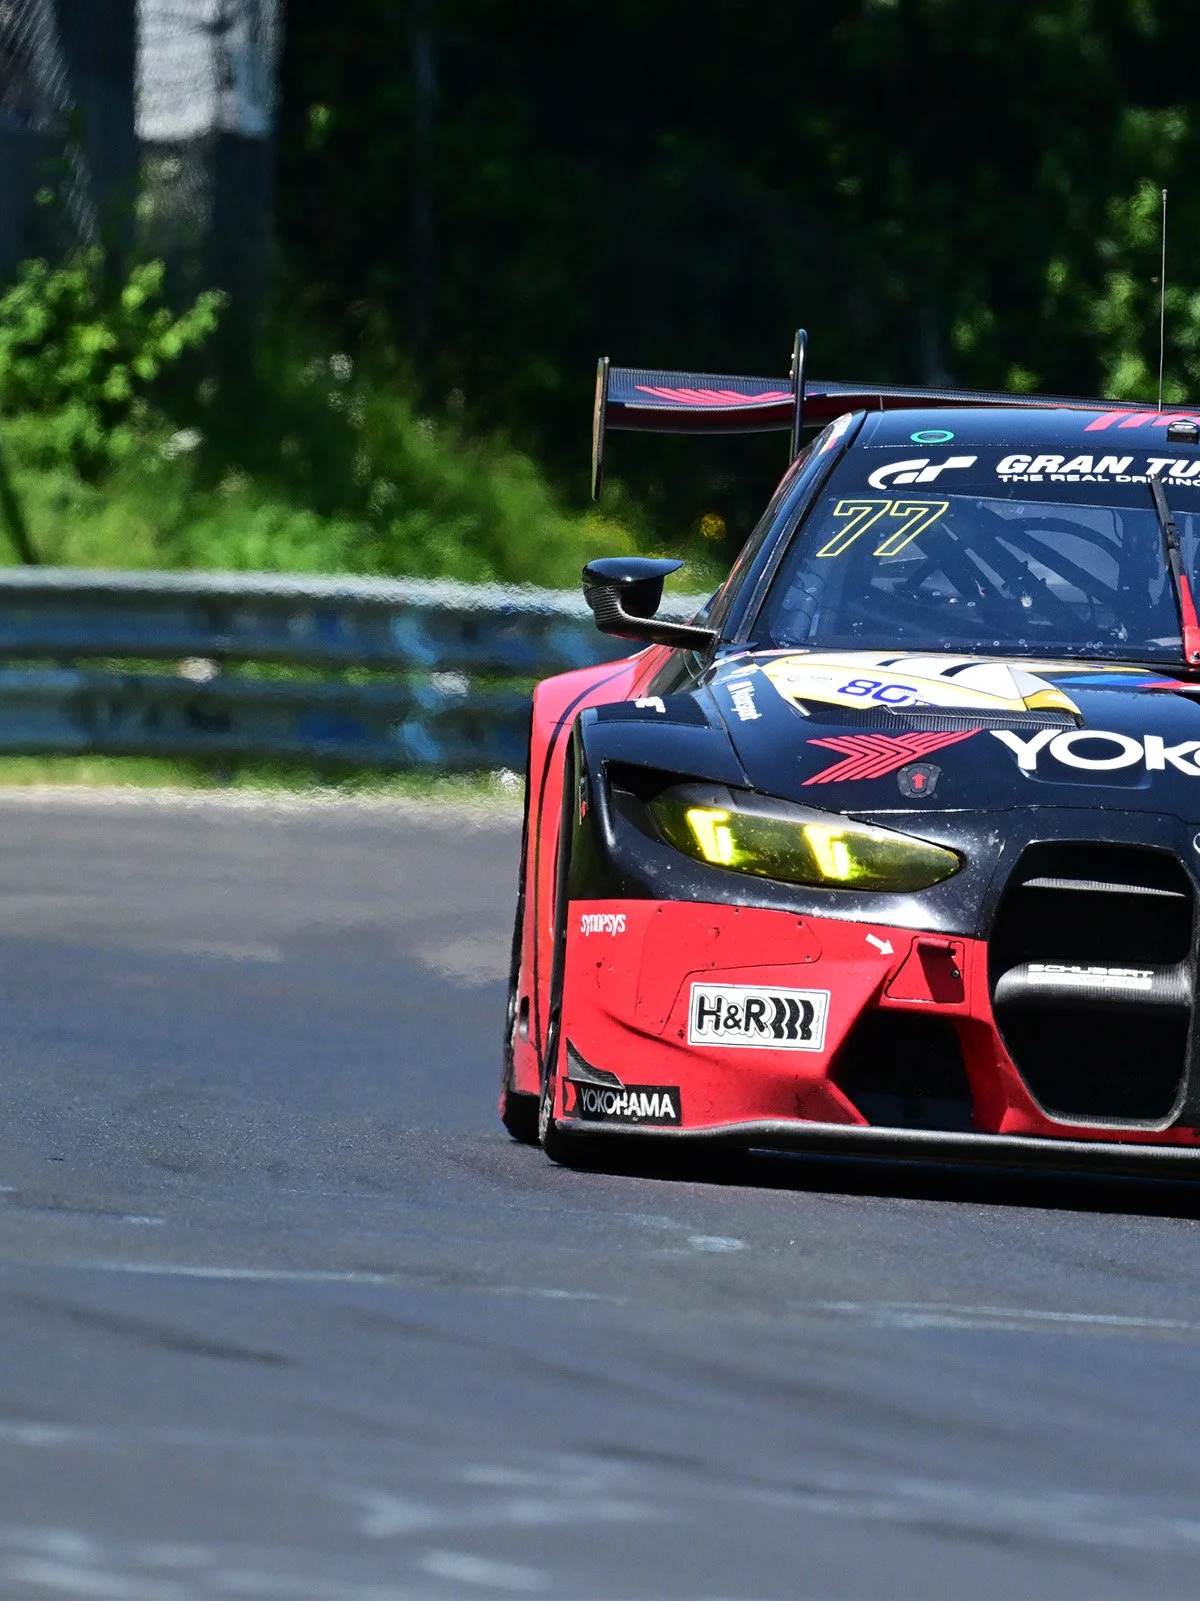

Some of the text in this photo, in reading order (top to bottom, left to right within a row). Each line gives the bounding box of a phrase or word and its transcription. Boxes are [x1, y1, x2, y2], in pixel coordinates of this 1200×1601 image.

[996, 454, 1134, 474] GRAN
[998, 474, 1044, 483] THE
[1051, 474, 1109, 483] REAL
[817, 500, 950, 557] 77
[1028, 964, 1154, 978] SCHUBERT
[696, 994, 768, 1034] H&R
[580, 1088, 676, 1119] YOKOHAMA
